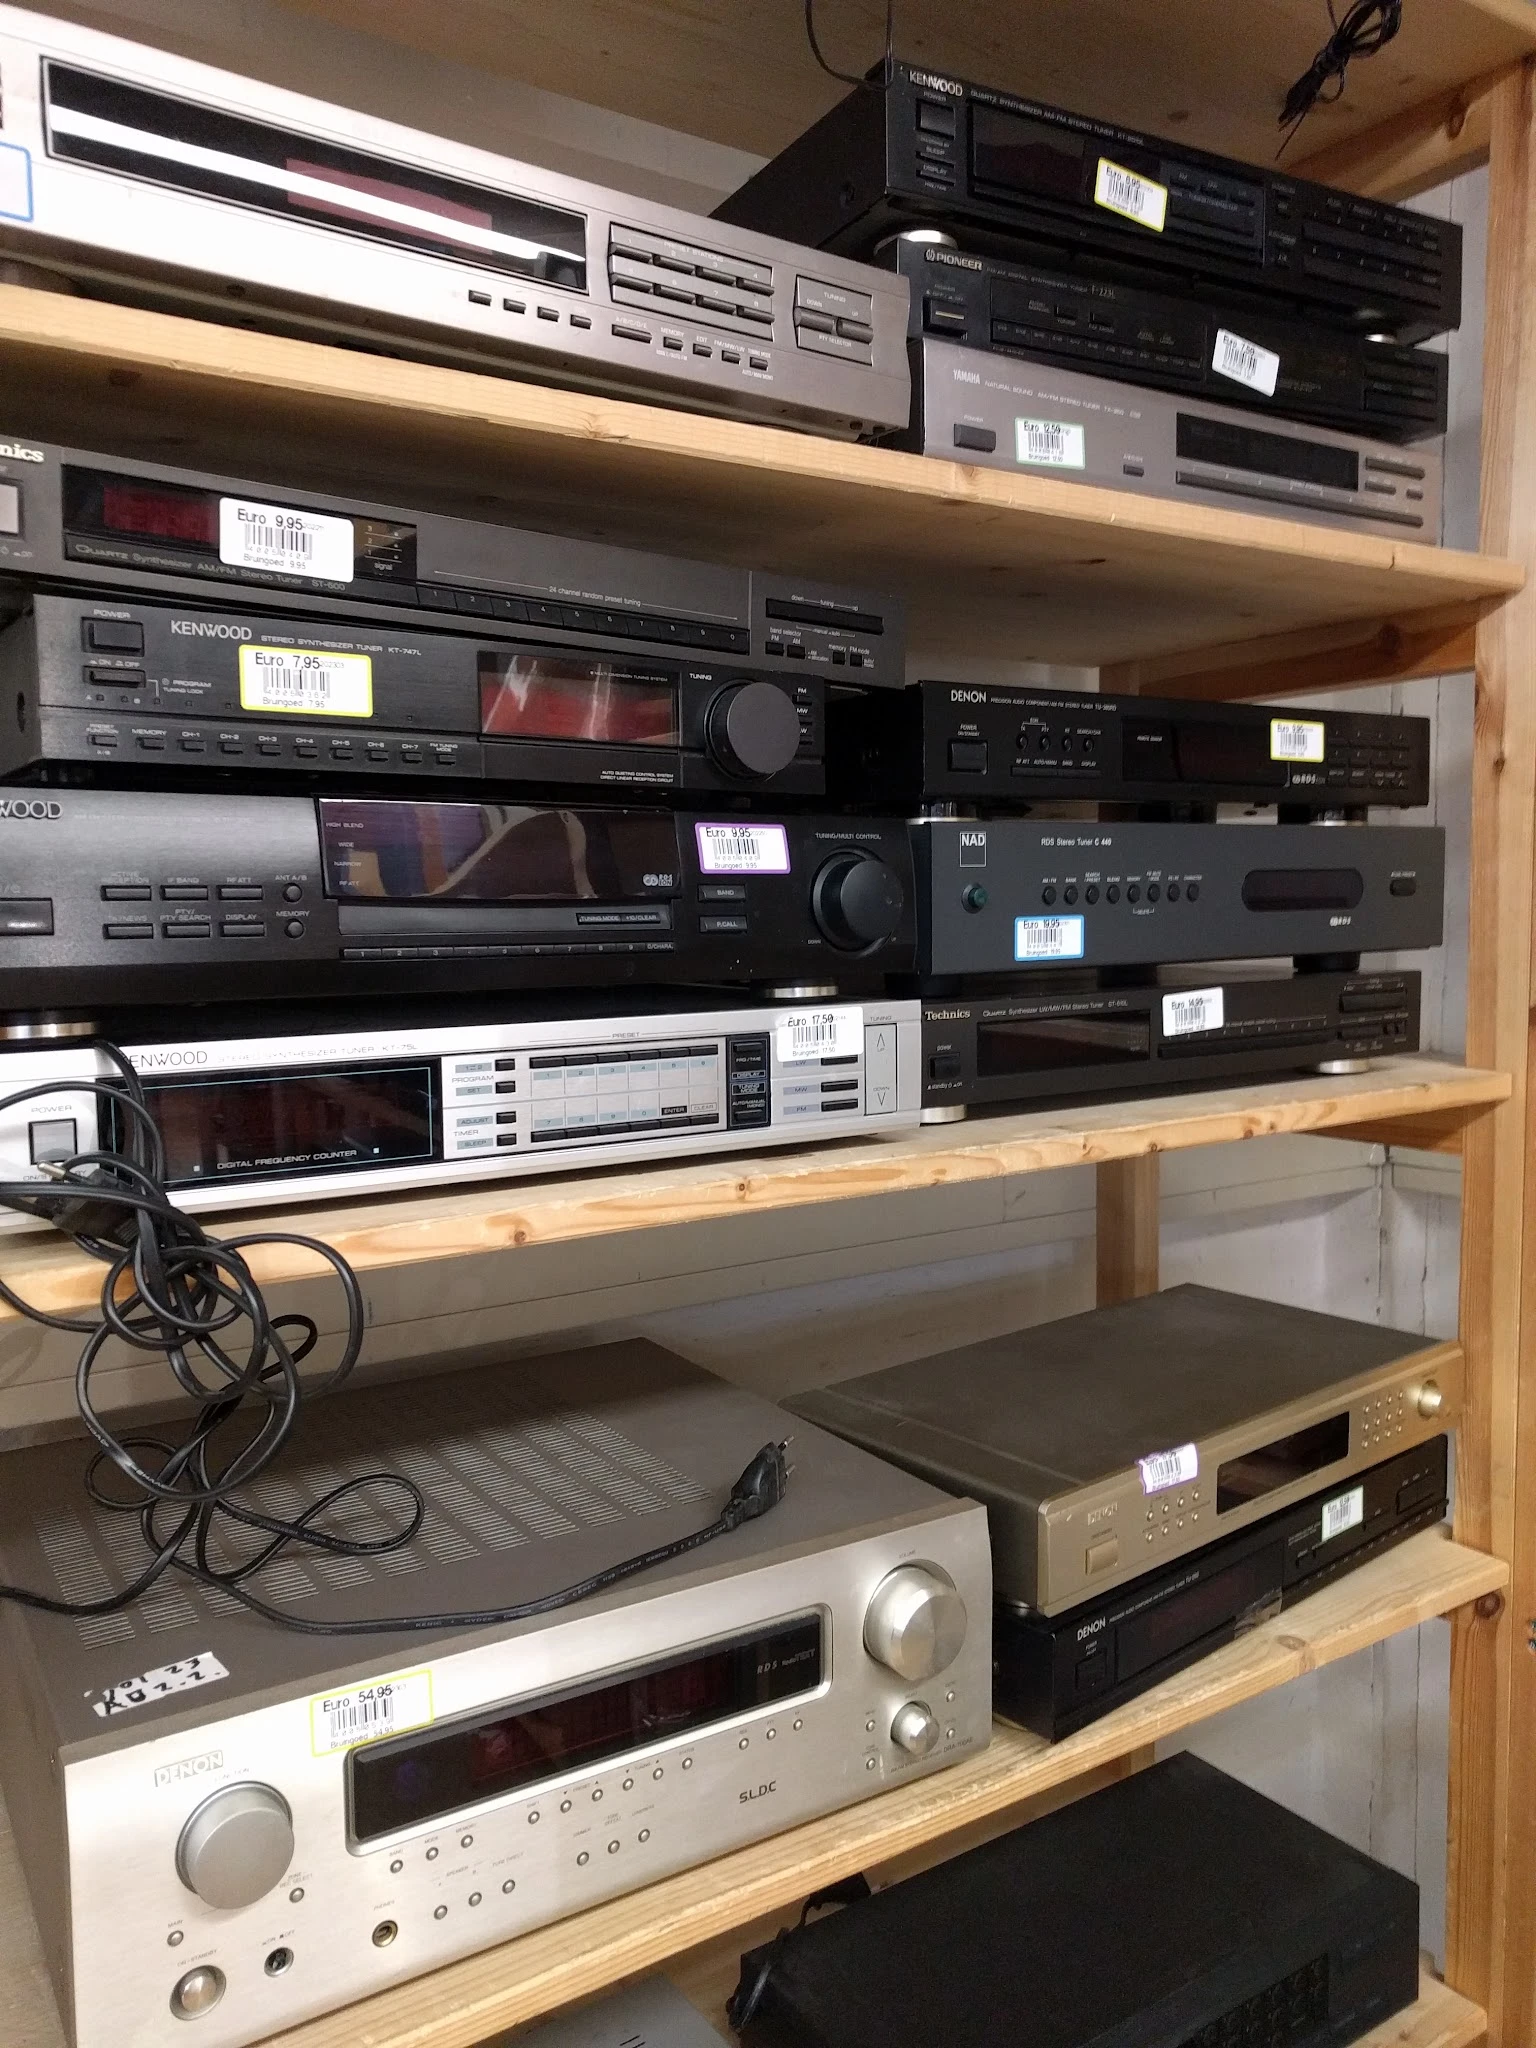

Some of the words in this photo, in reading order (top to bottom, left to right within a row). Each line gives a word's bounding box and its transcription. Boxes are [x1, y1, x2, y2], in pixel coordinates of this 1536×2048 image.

[909, 70, 963, 97] KENWOOD
[936, 253, 983, 271] PIONEER
[807, 298, 822, 307] DOWN
[660, 327, 685, 337] MEMORY
[696, 335, 708, 343] EDIT
[953, 368, 981, 385] YAMAHA
[1023, 421, 1040, 433] Euro
[237, 508, 267, 525] Euro
[275, 514, 304, 531] 9,95
[243, 553, 285, 567] Bruingoed
[289, 557, 307, 570] 9.95
[132, 553, 192, 569] Synthesizer
[197, 562, 237, 576] AM/FM
[240, 568, 273, 582] Stereo
[276, 574, 303, 585] Tuner
[549, 585, 557, 593] 24
[558, 587, 580, 597] channel
[582, 591, 603, 600] random
[605, 594, 623, 604] preset
[624, 597, 641, 607] tuning
[93, 609, 131, 619] POWER
[769, 626, 782, 634] band
[783, 628, 802, 637] selector
[170, 620, 252, 641] KENWOOD
[260, 635, 295, 645] STEREO
[297, 637, 354, 649] SYNTHESIZER
[356, 643, 383, 652] TUNER
[387, 646, 422, 656] KT-747L
[828, 643, 847, 652] memory
[255, 652, 284, 667] Euro
[292, 655, 321, 670] 7,95
[689, 672, 712, 682] TUNING
[172, 679, 212, 688] PROGRAM
[950, 689, 987, 703] DENON
[263, 697, 303, 708] Bruingoed
[309, 699, 325, 709] 7.95
[132, 728, 167, 736] MEMORY
[258, 735, 278, 743] CH-3
[332, 739, 350, 747] CH-5
[705, 827, 726, 838] Euro
[731, 827, 751, 839] 9,95
[961, 834, 985, 847] NAD
[1041, 838, 1055, 846] RDS
[1056, 837, 1075, 846] Stereo
[1077, 838, 1093, 846] Tuner
[714, 862, 743, 870] Bruingoed
[225, 913, 257, 921] DISPLAY
[275, 910, 310, 918] MEMORY
[1023, 920, 1039, 930] Euro
[1043, 919, 1060, 930] 19,95
[925, 1009, 971, 1021] Technics
[1008, 1007, 1038, 1016] Synthesizer
[1072, 1002, 1089, 1010] Stereo
[1090, 1001, 1103, 1009] Tuner
[1171, 1001, 1185, 1010] Euro
[787, 1017, 807, 1027] Euro
[811, 1013, 834, 1025] 17,50
[124, 1050, 208, 1069] ENWOOD
[341, 1046, 375, 1055] TUNER
[382, 1044, 418, 1052] KT-75L
[792, 1048, 819, 1057] Bruingoed
[451, 1075, 494, 1083] PROGRAM
[31, 1105, 72, 1113] POWER
[461, 1117, 488, 1125] ADJUST
[454, 1129, 479, 1137] TIMER
[216, 1159, 253, 1170] DIGITAL
[254, 1154, 312, 1166] FREQUENCY
[313, 1149, 357, 1161] COUNTER
[1077, 1616, 1106, 1641] DENON
[756, 1661, 778, 1674] RDS
[323, 1697, 350, 1713] Euro
[358, 1684, 393, 1703] 54,95
[330, 1733, 369, 1749] Bruingoed
[373, 1726, 395, 1738] 54.95
[154, 1750, 223, 1787] DENON
